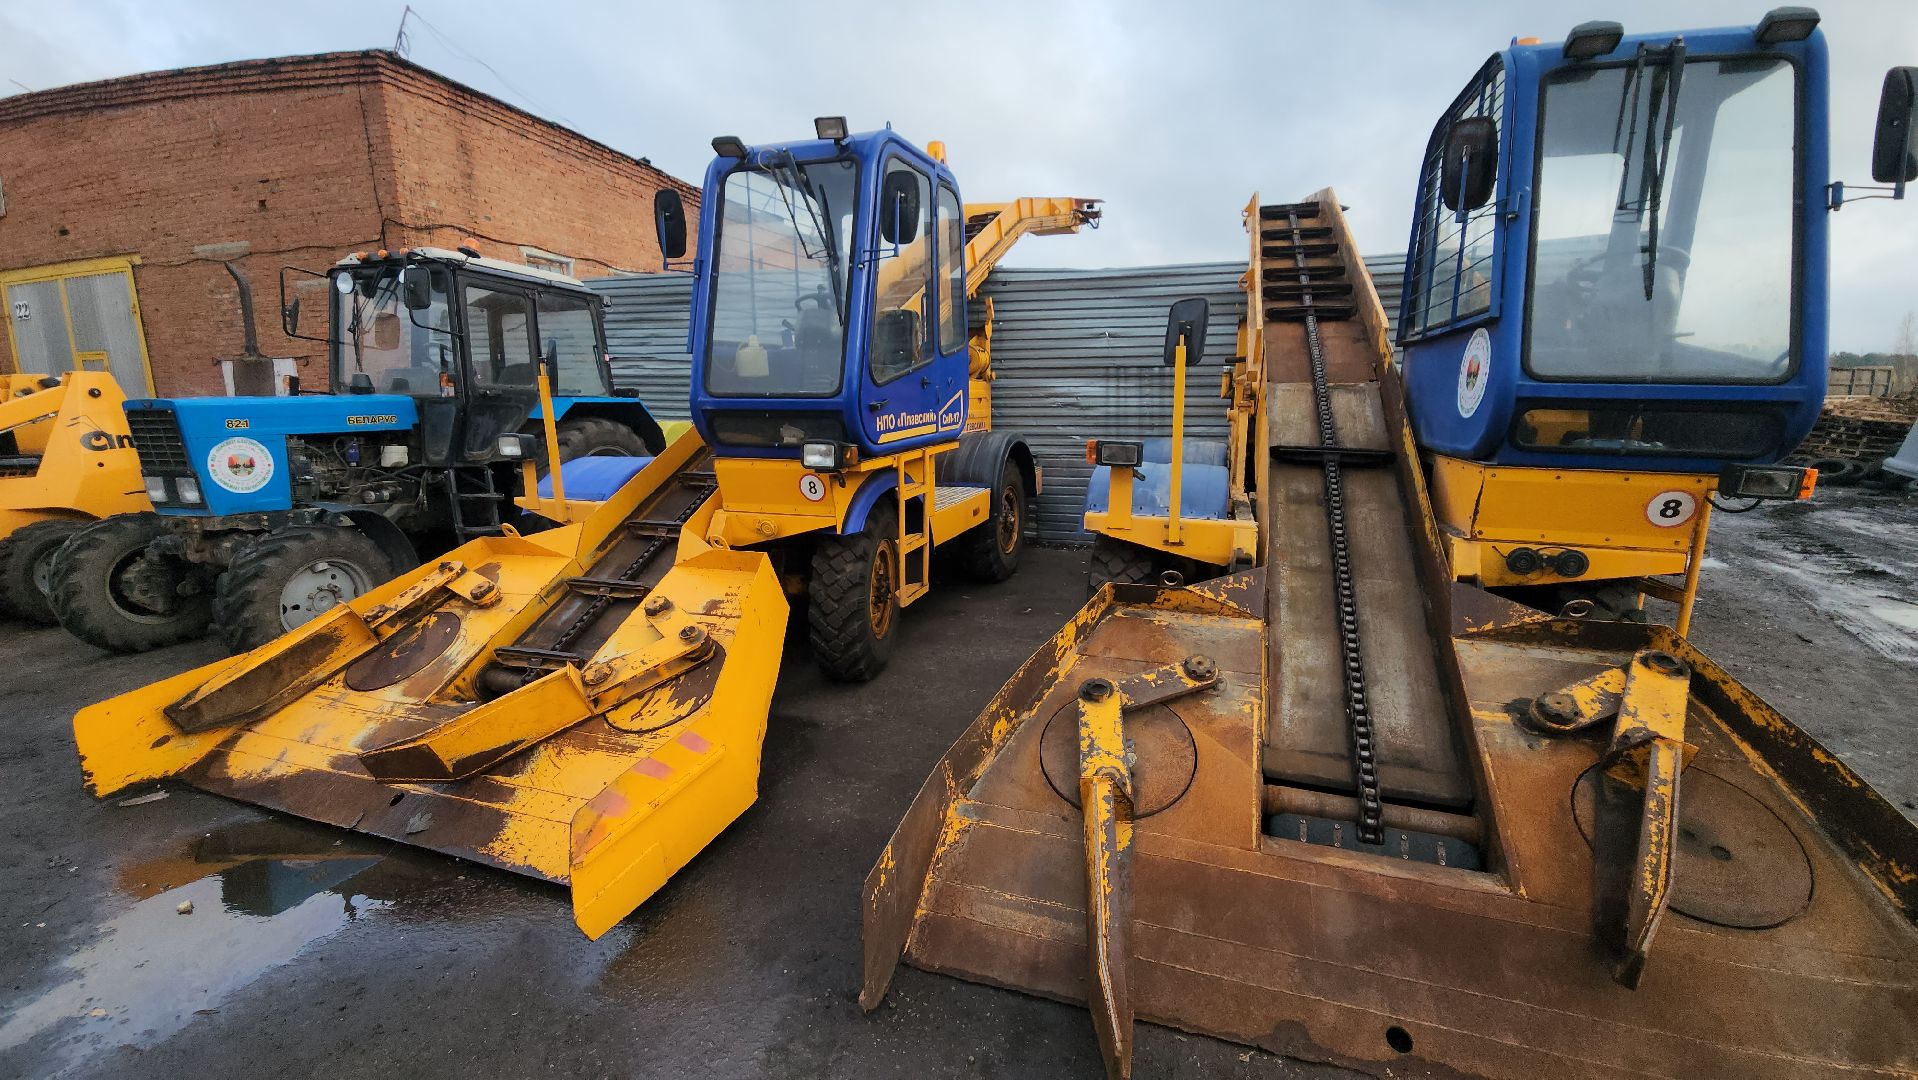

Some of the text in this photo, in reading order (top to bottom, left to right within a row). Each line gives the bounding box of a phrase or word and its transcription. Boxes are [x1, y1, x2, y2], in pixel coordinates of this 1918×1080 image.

[15, 302, 30, 319] 22
[347, 415, 398, 425] БЕЛАРУС
[876, 413, 895, 431] НПО
[808, 480, 817, 495] 8
[1659, 499, 1682, 518] 8
